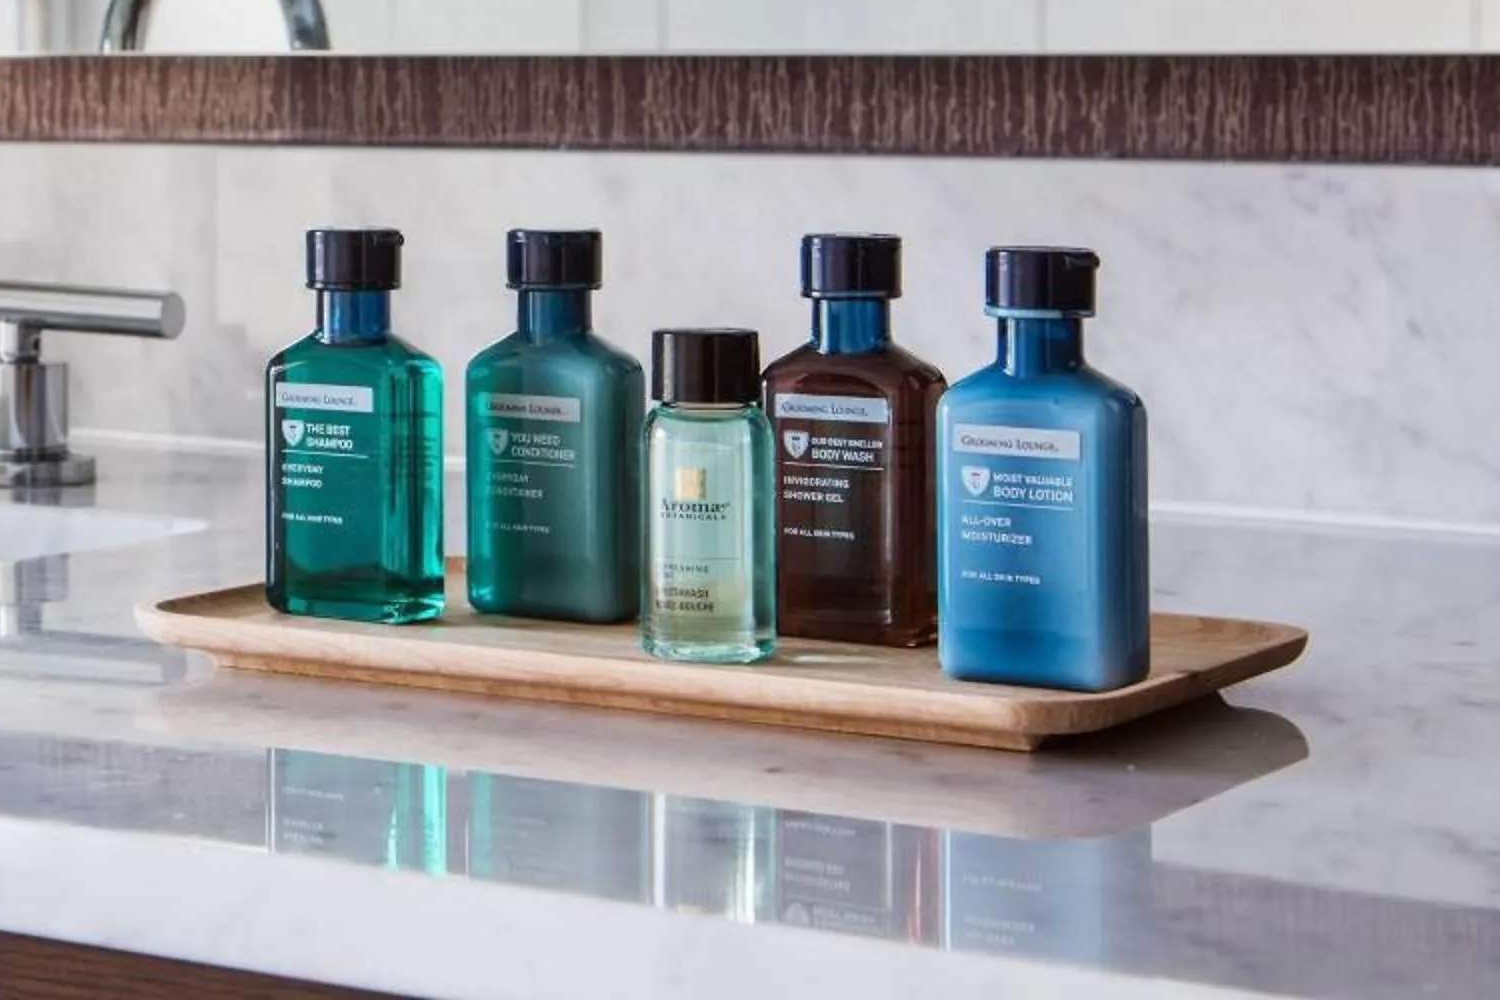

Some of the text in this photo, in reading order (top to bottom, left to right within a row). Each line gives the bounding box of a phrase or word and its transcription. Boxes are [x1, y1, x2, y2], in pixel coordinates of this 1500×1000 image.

[306, 423, 351, 436] THE BEST
[306, 436, 353, 449] SHAMPOO
[511, 432, 560, 445] YOU NEED
[511, 447, 575, 461] CONDITIONER
[812, 448, 874, 462] BODY WASH
[783, 475, 850, 488] INVIGORATING
[1024, 474, 1073, 487] VALUABLE
[783, 491, 844, 503] SHOWER GEL
[993, 486, 1073, 503] BODY LOTION
[961, 515, 1012, 528] ALL-OVER
[961, 531, 1033, 545] MOISTURIZER
